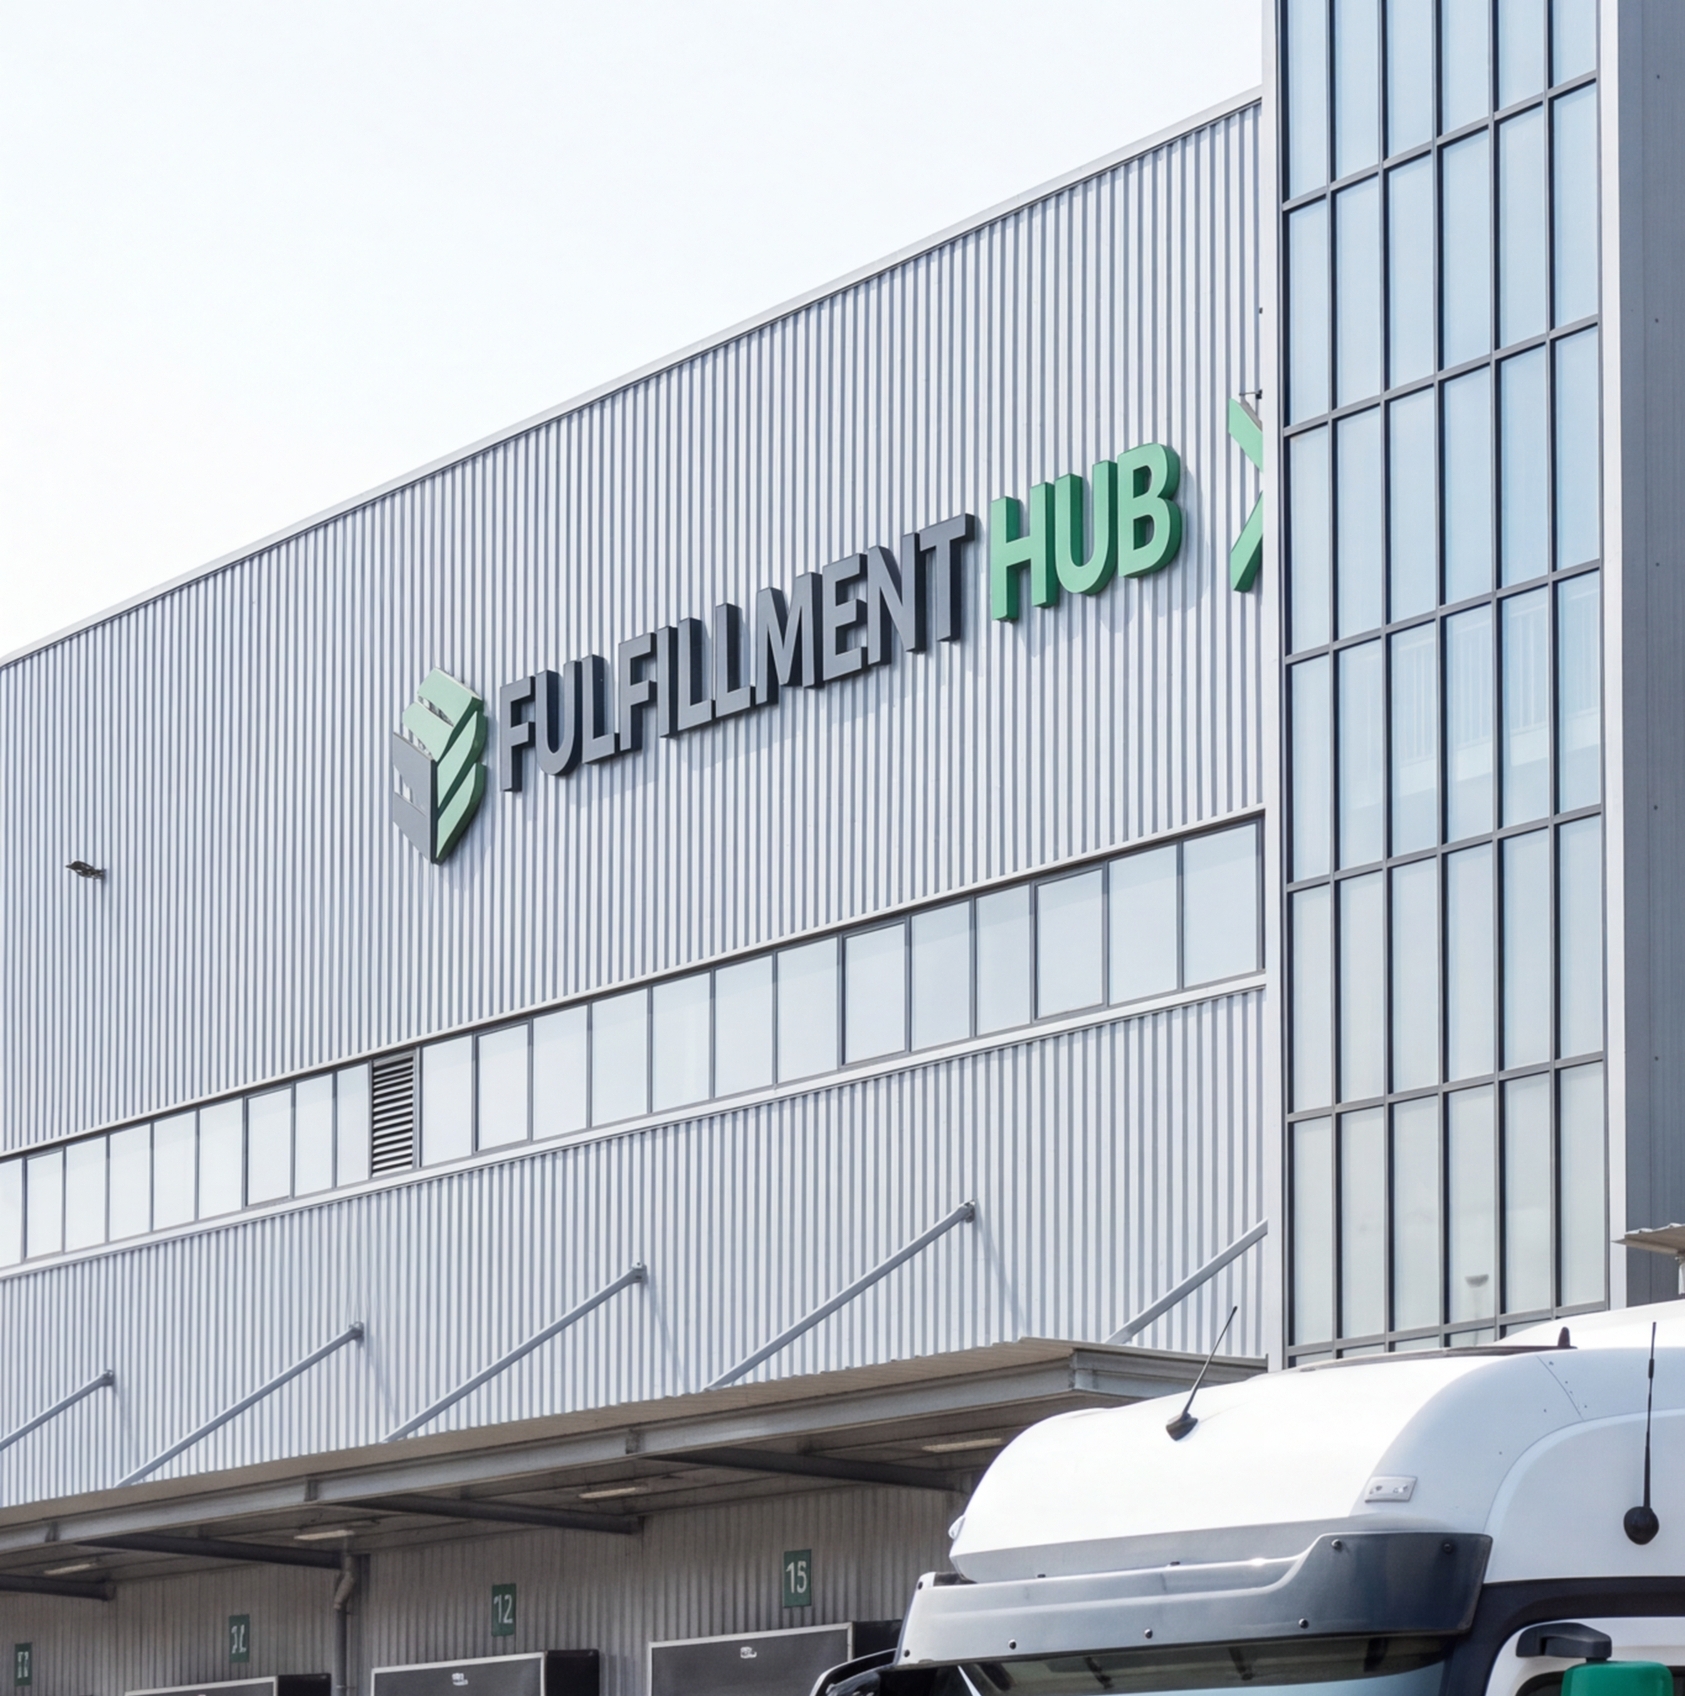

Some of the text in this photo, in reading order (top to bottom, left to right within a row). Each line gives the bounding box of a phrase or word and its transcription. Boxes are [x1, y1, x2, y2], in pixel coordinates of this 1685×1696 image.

[499, 441, 1182, 793] FULFILLMENT HUB
[785, 1560, 807, 1594] 15
[493, 1594, 513, 1624] 12
